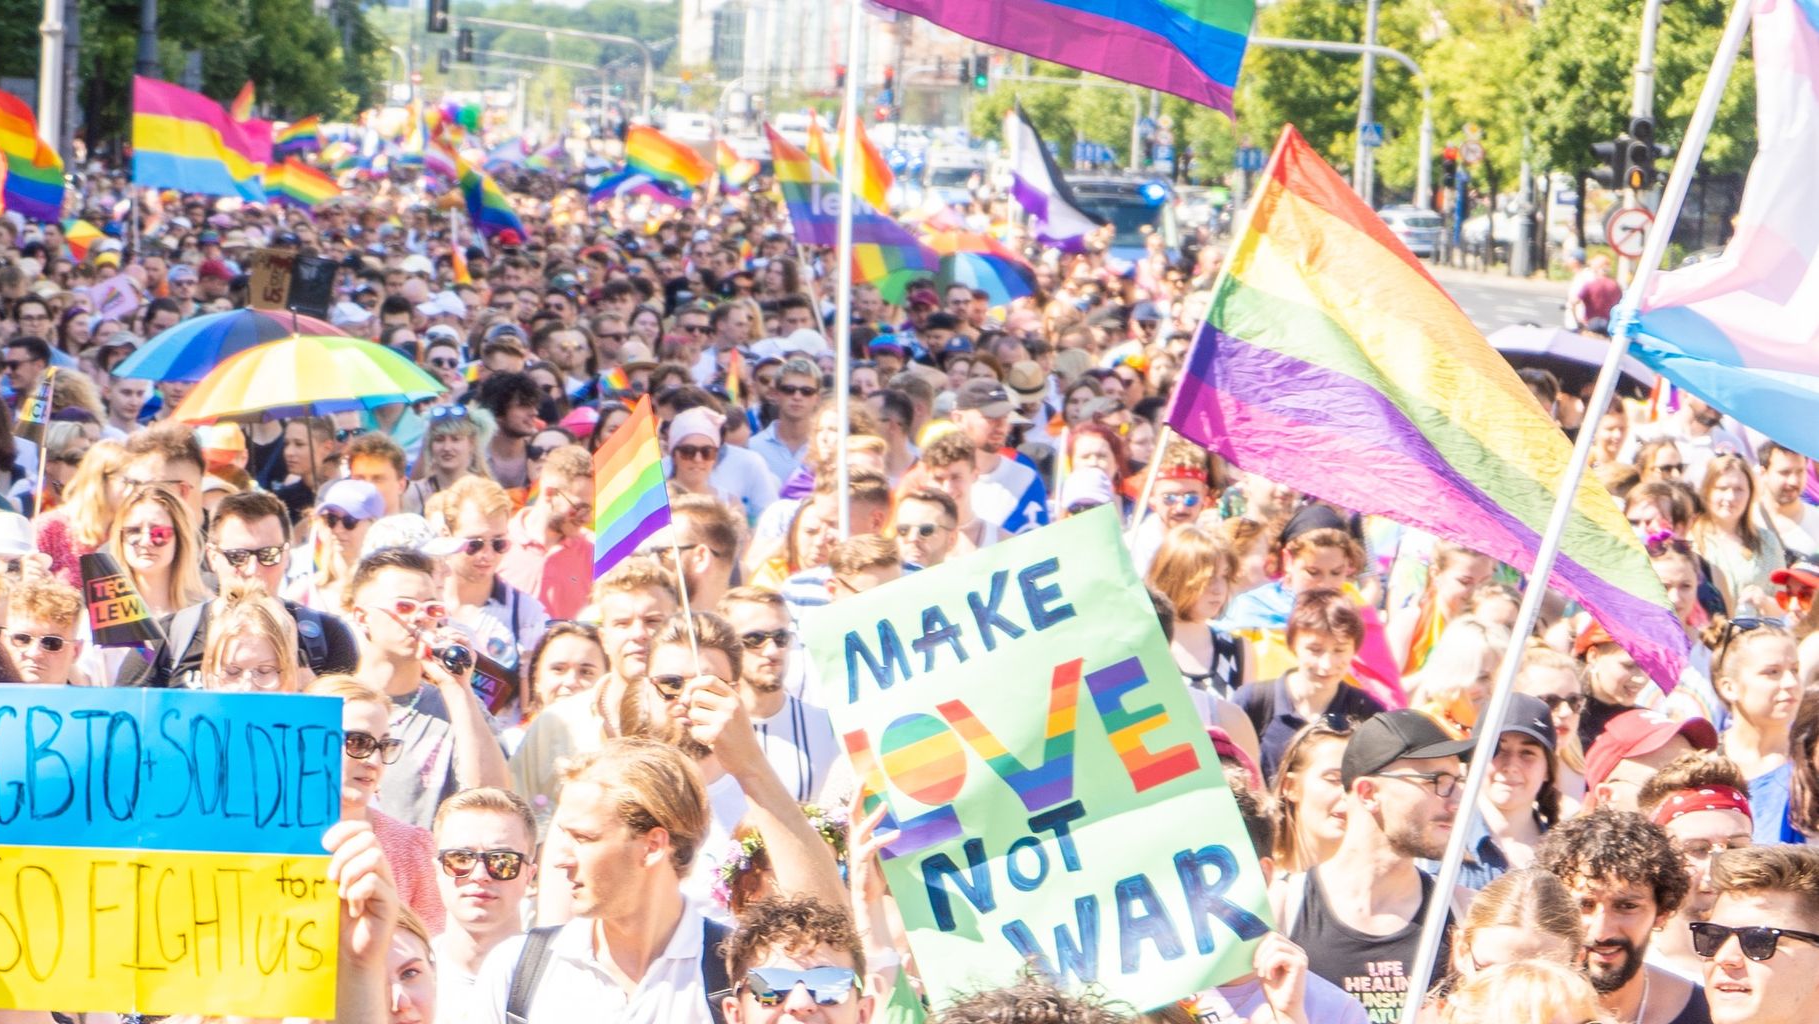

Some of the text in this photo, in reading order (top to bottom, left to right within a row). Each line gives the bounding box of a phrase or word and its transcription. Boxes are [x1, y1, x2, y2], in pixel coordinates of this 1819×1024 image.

[845, 556, 1076, 704] MAKE
[842, 655, 1202, 861] LOVE
[86, 860, 256, 979] FIGHT
[274, 861, 327, 900] for
[920, 800, 1086, 932] NOT
[1001, 844, 1272, 985] WAR
[1344, 976, 1412, 992] HEALIN
[1367, 960, 1404, 977] LIFE
